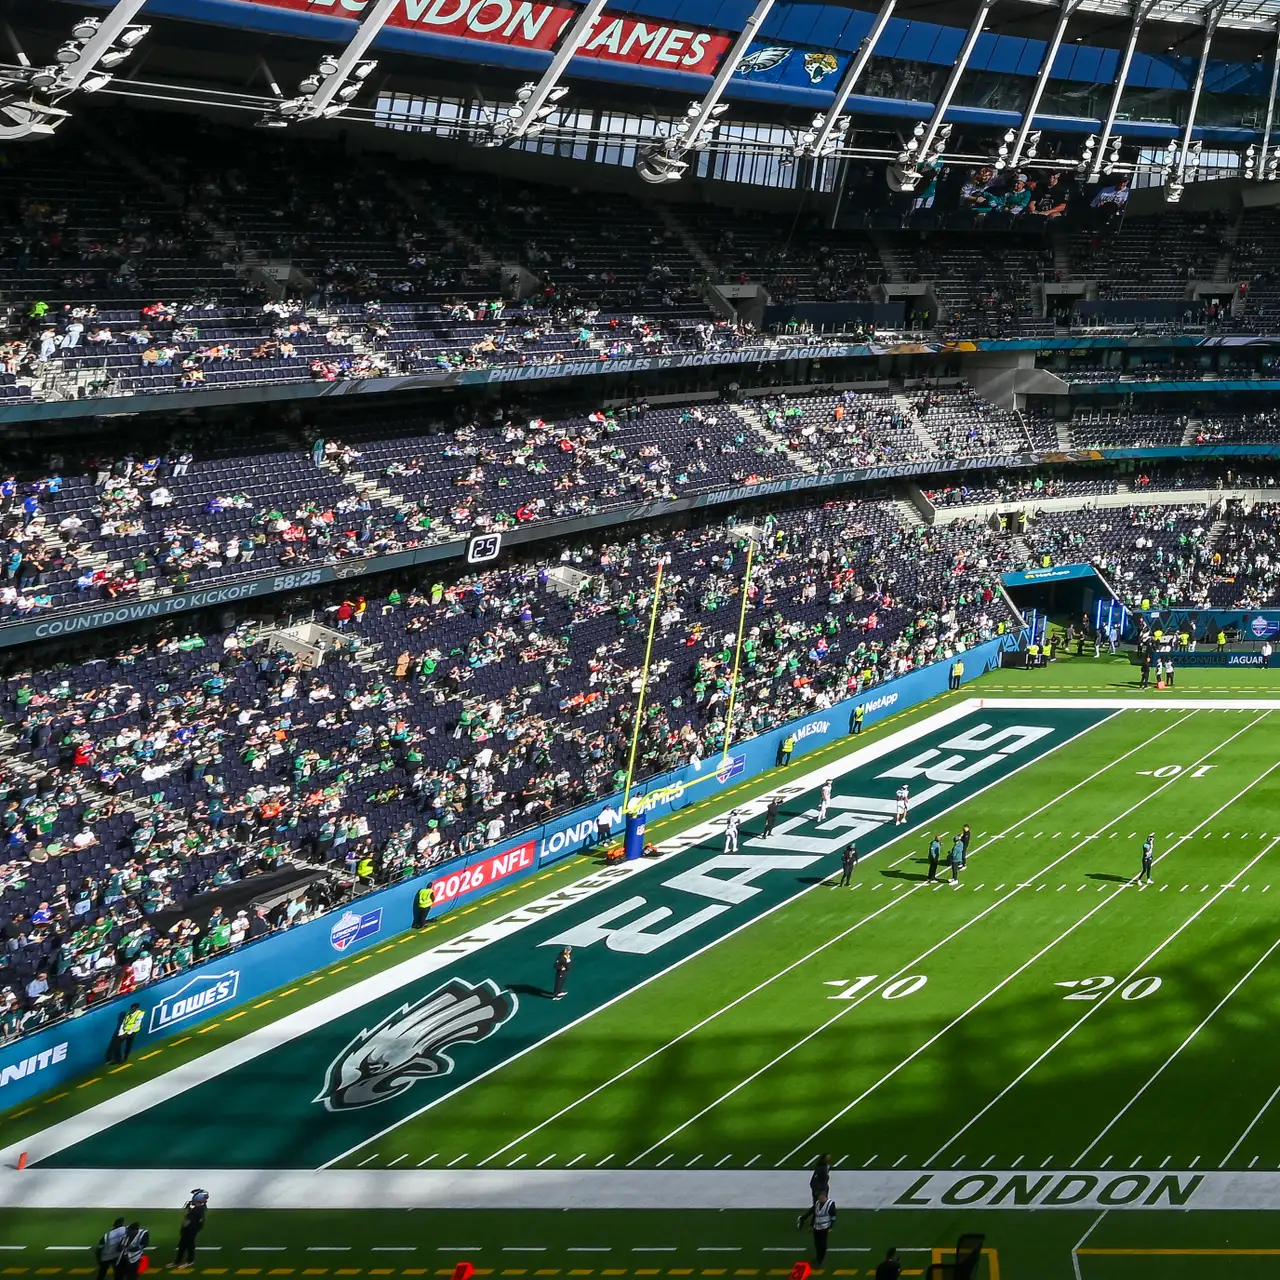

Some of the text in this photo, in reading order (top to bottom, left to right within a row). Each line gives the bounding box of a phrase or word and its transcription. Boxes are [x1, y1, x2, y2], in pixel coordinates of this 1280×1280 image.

[487, 361, 597, 383] PHILADELPHIA
[600, 358, 652, 374] EAGLES
[677, 348, 779, 367] JACKSONVILLE
[779, 346, 848, 361] JAGUARS
[706, 477, 799, 505] PHILADELPHIA
[798, 473, 837, 490] EAGLES
[861, 460, 960, 480] JACKSONVILLE
[961, 455, 1023, 470] JAGUARS
[473, 539, 495, 557] 25
[35, 569, 322, 638] COUNTDOWN TO KICKOFF 58:25
[1228, 655, 1264, 665] JAGUAR
[864, 692, 899, 715] NetApp
[789, 722, 831, 744] AMESON
[535, 722, 1056, 956] EAGLES
[433, 864, 484, 903] 2026
[490, 847, 531, 879] NFL
[433, 935, 490, 954] IT
[493, 868, 634, 926] TAKES
[159, 979, 233, 1026] LOWE'S
[826, 974, 928, 1000] 10
[1062, 975, 1162, 1000] 20
[892, 1174, 1205, 1206] LONDON
